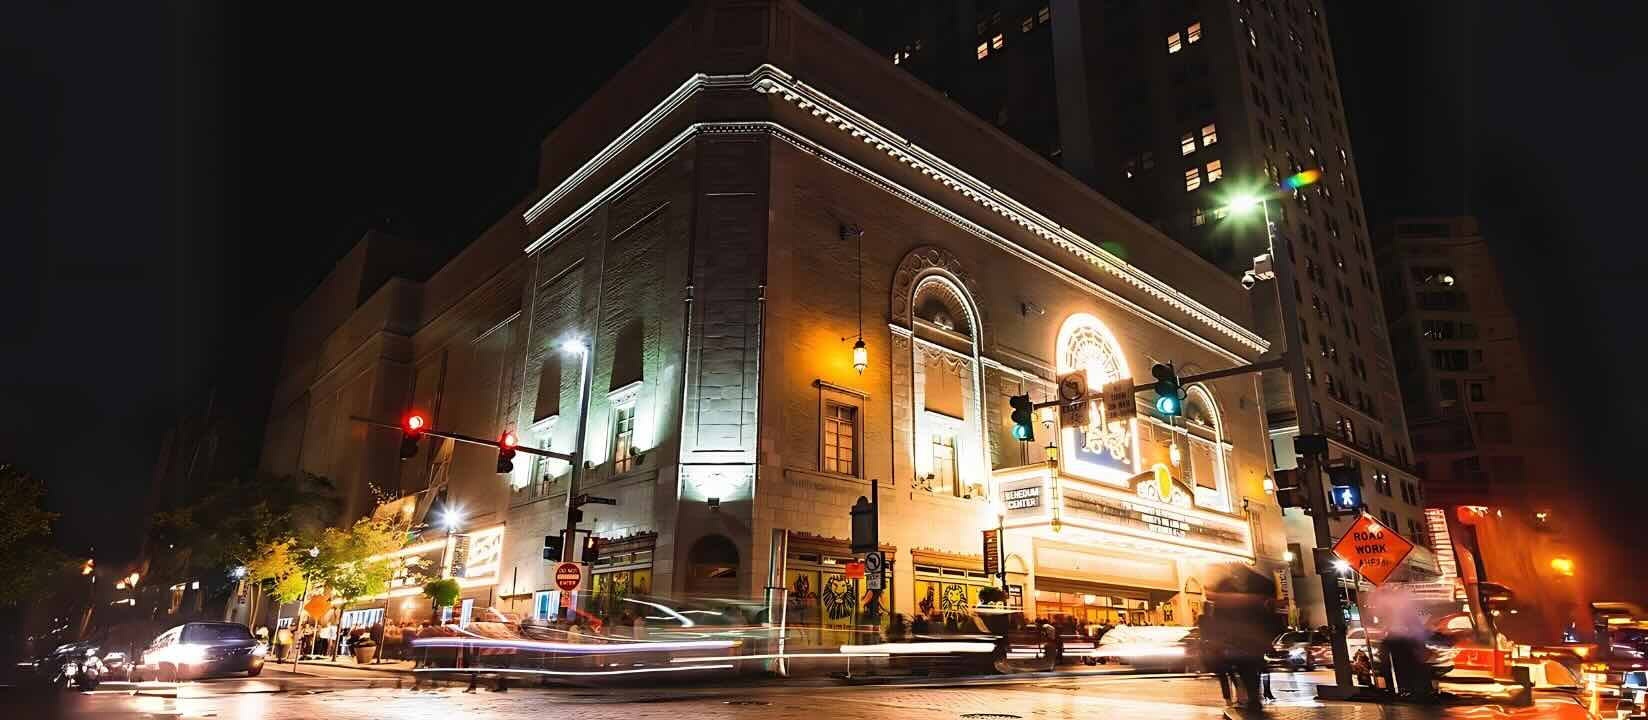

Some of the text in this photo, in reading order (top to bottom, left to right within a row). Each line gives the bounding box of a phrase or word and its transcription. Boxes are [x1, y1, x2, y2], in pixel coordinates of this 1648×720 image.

[1007, 497, 1036, 509] CENTER
[1353, 530, 1384, 541] ROAD
[1355, 543, 1386, 554] WORK
